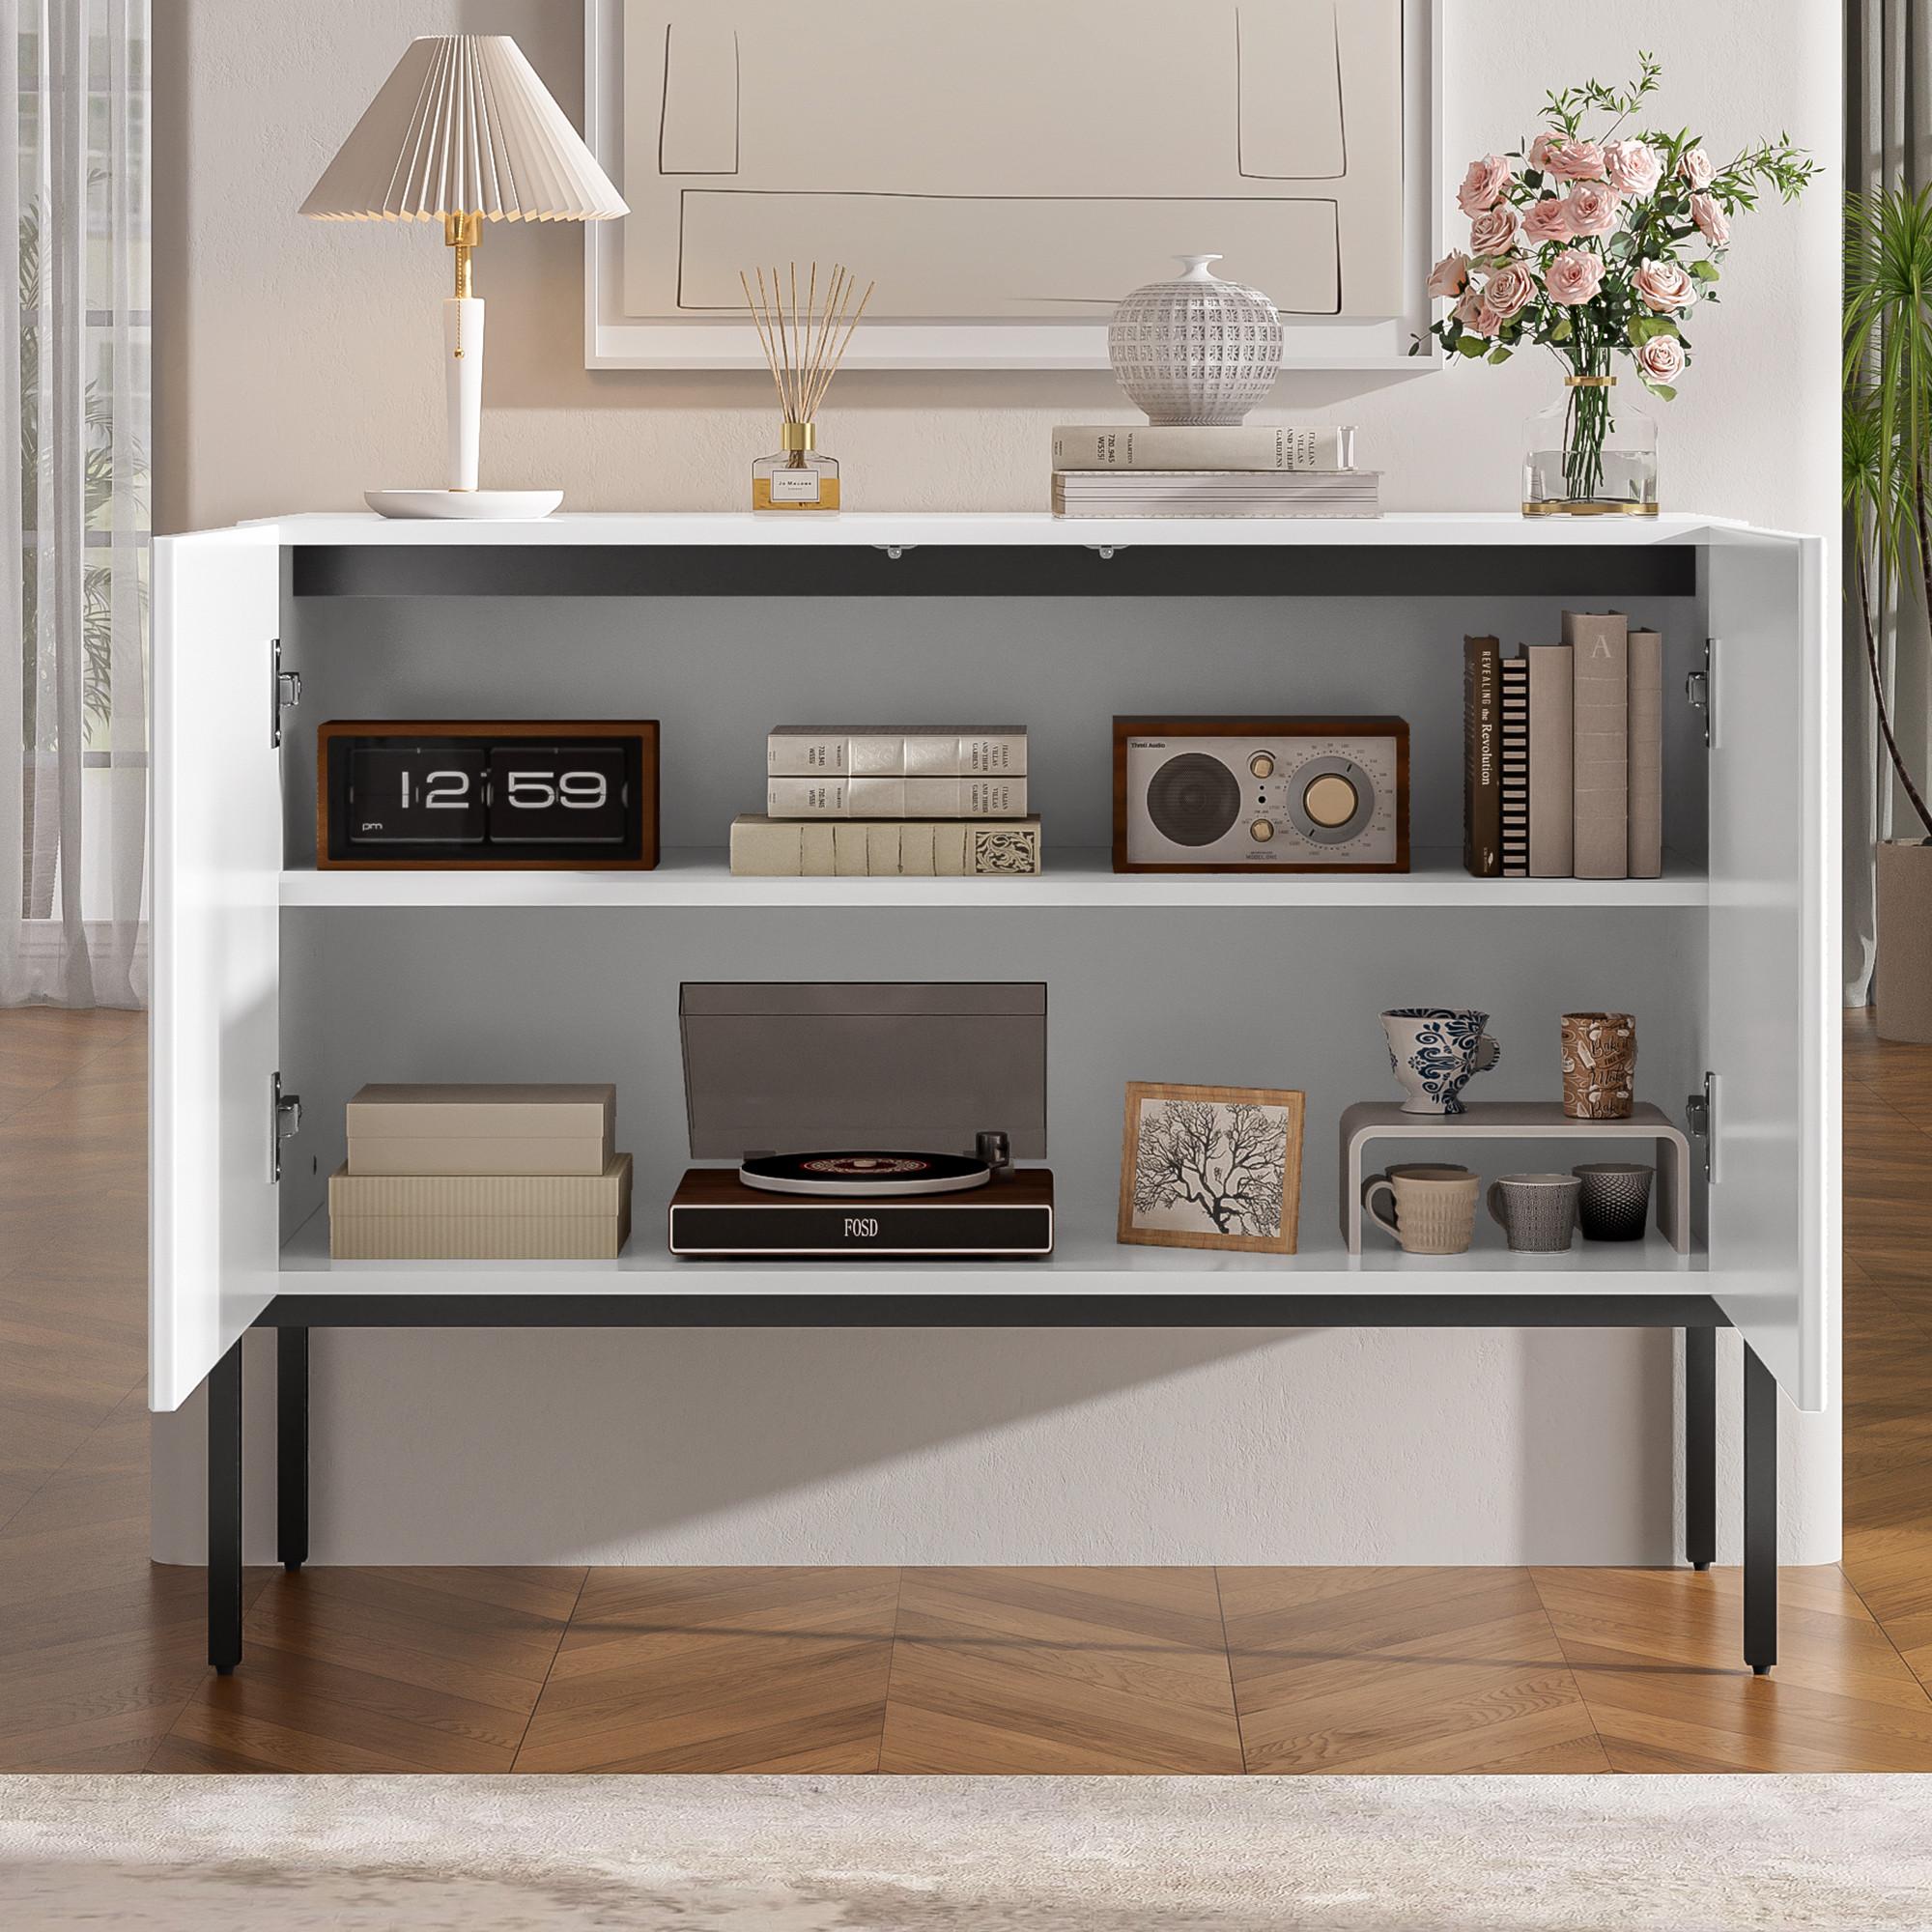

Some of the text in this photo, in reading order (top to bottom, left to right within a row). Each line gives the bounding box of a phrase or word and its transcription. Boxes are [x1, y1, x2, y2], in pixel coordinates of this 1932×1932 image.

[1592, 634, 1612, 659] A
[1481, 650, 1492, 785] REVEALING the Revolution
[401, 770, 607, 810] 12 59
[362, 822, 384, 832] pm
[843, 1218, 879, 1237] FOSD
